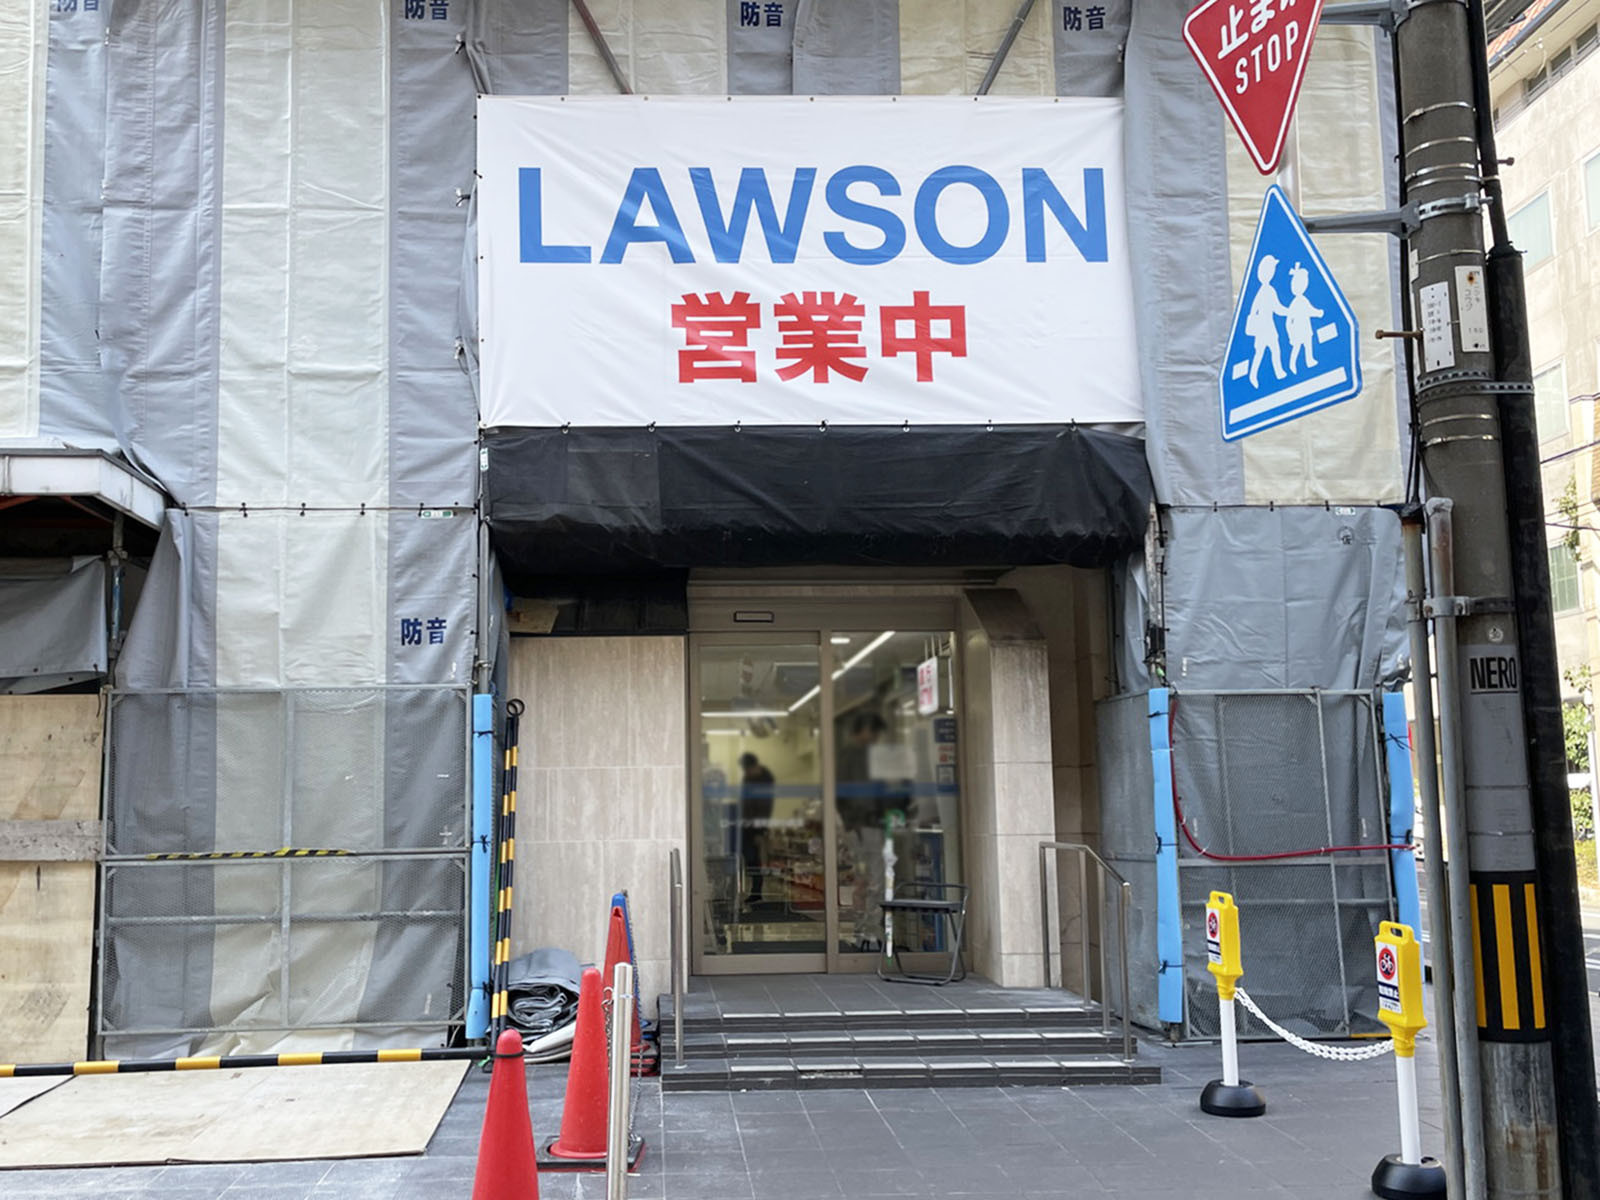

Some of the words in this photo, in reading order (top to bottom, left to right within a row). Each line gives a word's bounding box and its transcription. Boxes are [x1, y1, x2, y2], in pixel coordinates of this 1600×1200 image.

[405, 0, 449, 20] 防音
[741, 2, 783, 27] 防音
[1063, 6, 1106, 31] 防音
[1235, 20, 1299, 94] STOP
[518, 164, 1109, 266] LAWSON
[670, 291, 967, 384] 営業中
[400, 617, 447, 646] 防音
[1469, 656, 1518, 690] NERO
